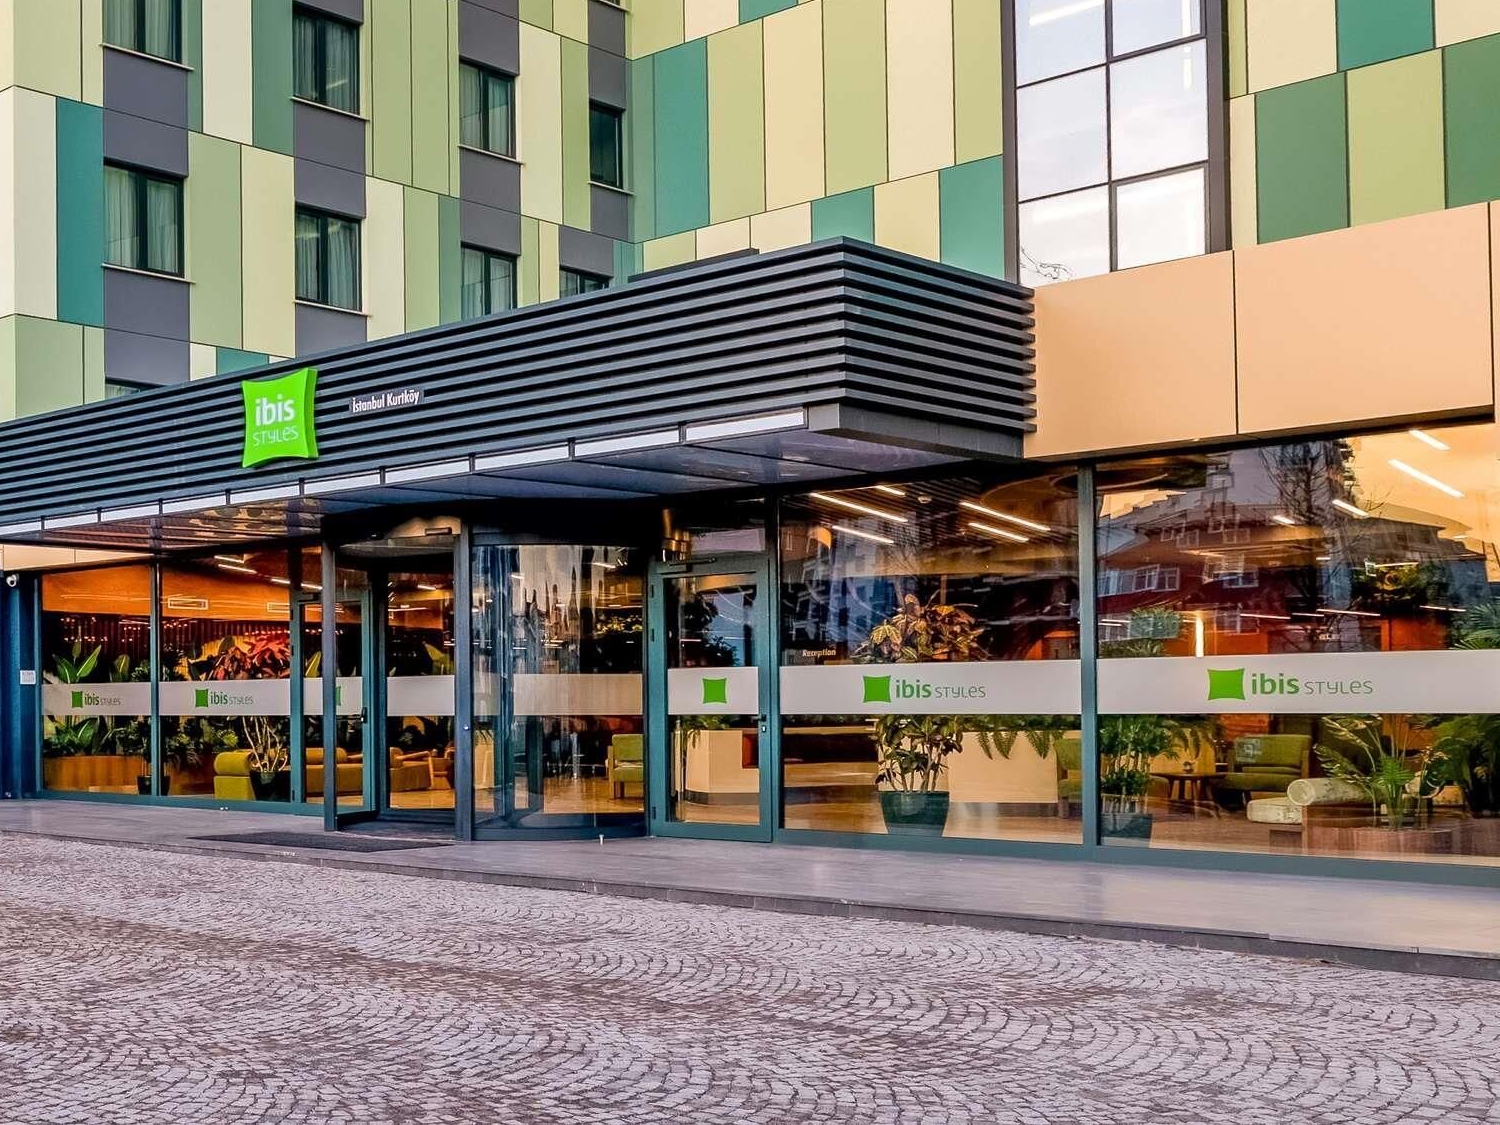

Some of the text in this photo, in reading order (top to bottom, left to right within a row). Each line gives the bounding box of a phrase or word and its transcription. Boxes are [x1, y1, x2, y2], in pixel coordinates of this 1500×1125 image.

[255, 393, 296, 427] ibis
[352, 389, 420, 413] İstanbul Kurtköy
[895, 679, 932, 699] ibis
[1251, 673, 1300, 695] ibis
[84, 692, 100, 706] ibis
[210, 691, 229, 706] ibis
